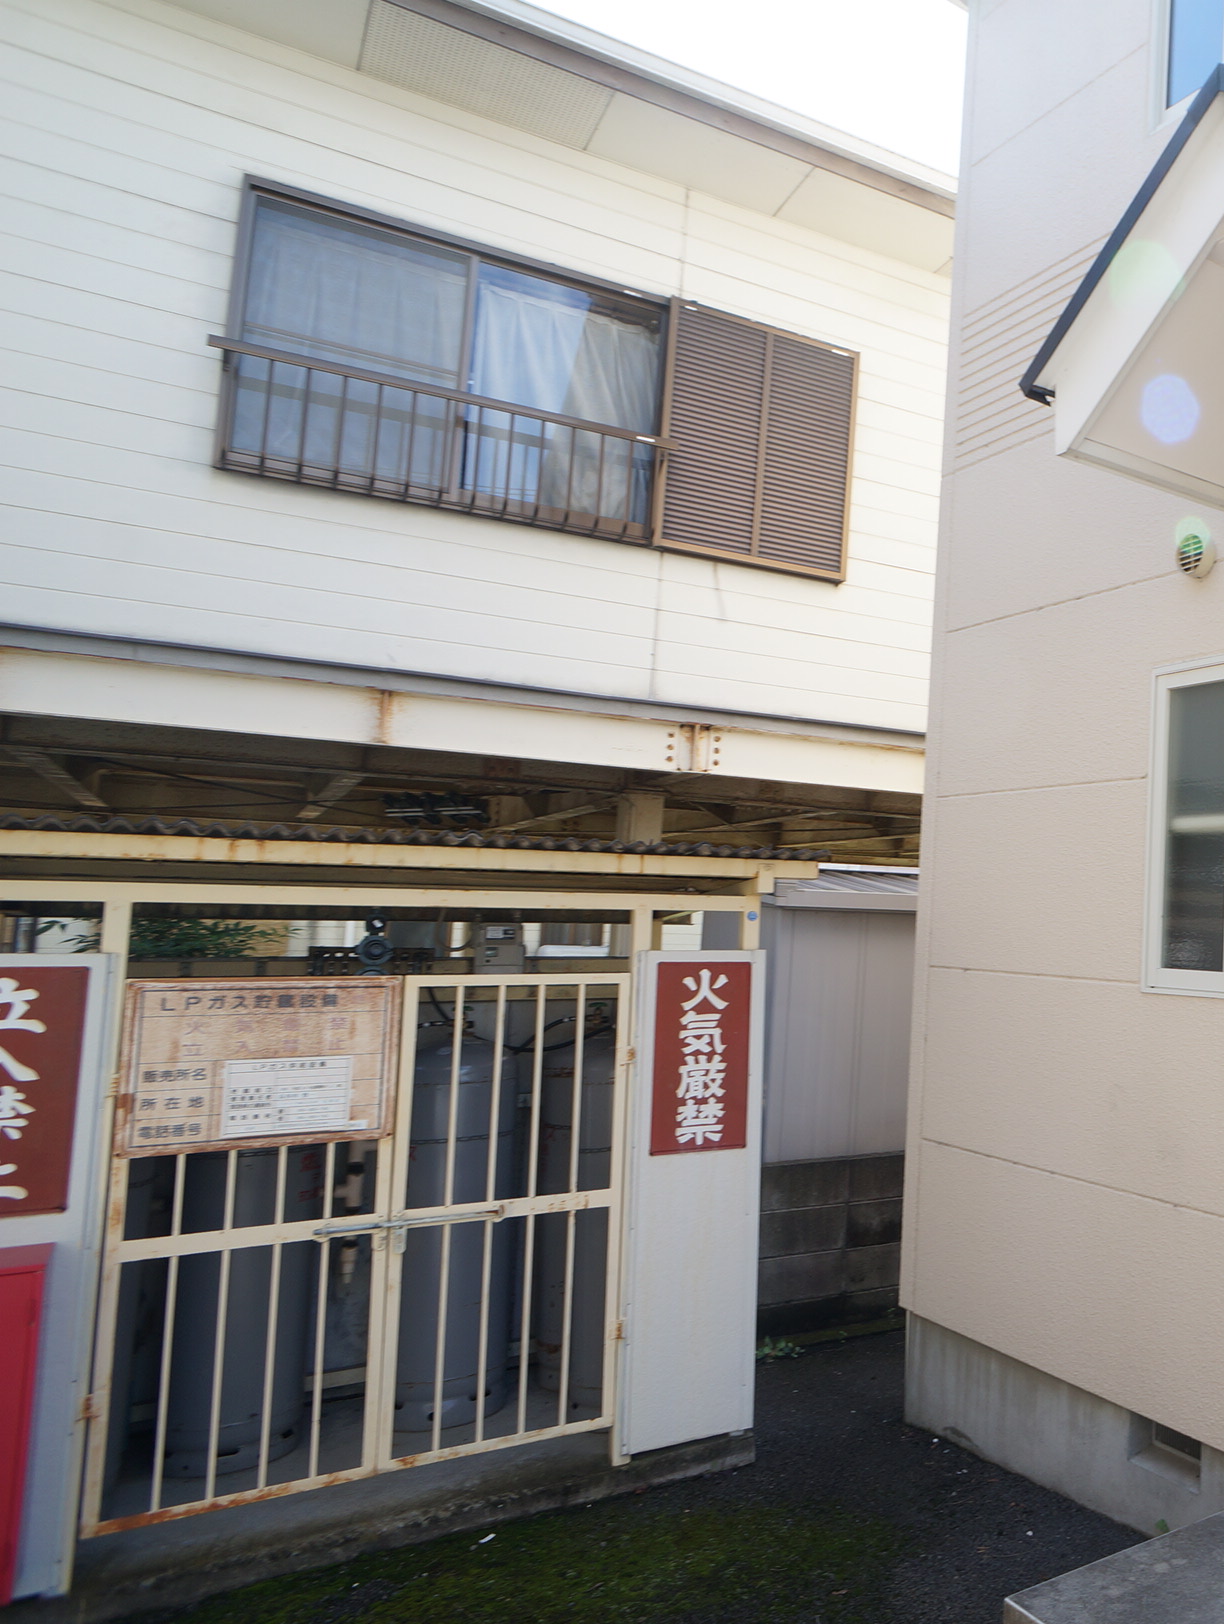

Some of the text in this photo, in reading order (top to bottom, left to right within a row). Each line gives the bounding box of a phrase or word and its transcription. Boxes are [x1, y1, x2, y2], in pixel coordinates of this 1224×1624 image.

[675, 968, 730, 1146] 火気厳禁
[139, 1096, 205, 1112] 所在地
[137, 1122, 203, 1140] 電話番号
